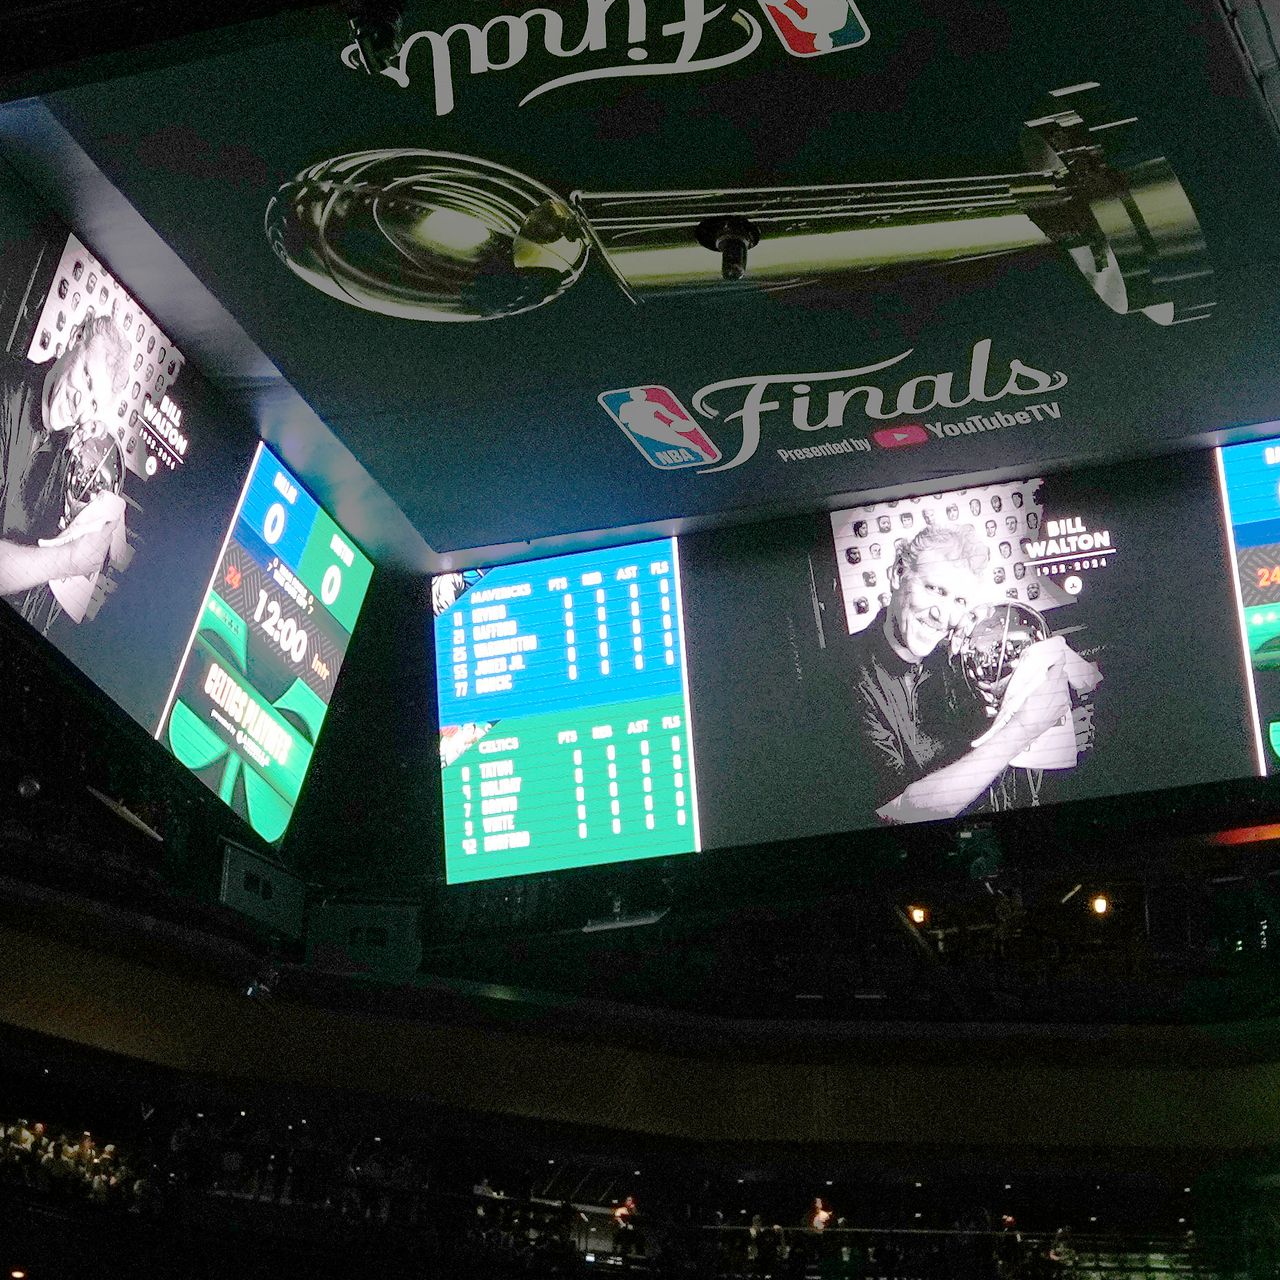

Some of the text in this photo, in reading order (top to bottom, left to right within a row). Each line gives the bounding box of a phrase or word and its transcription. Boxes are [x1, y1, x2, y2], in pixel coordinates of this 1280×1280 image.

[143, 398, 189, 456] WALTON
[691, 338, 1068, 475] Finals
[656, 447, 694, 466] NBA
[776, 436, 846, 464] Presented
[846, 436, 873, 456] by
[263, 502, 286, 545] 0
[1025, 530, 1111, 559] WALTON
[1046, 516, 1087, 537] BILL
[321, 564, 342, 606] 0
[252, 588, 308, 664] 12:00
